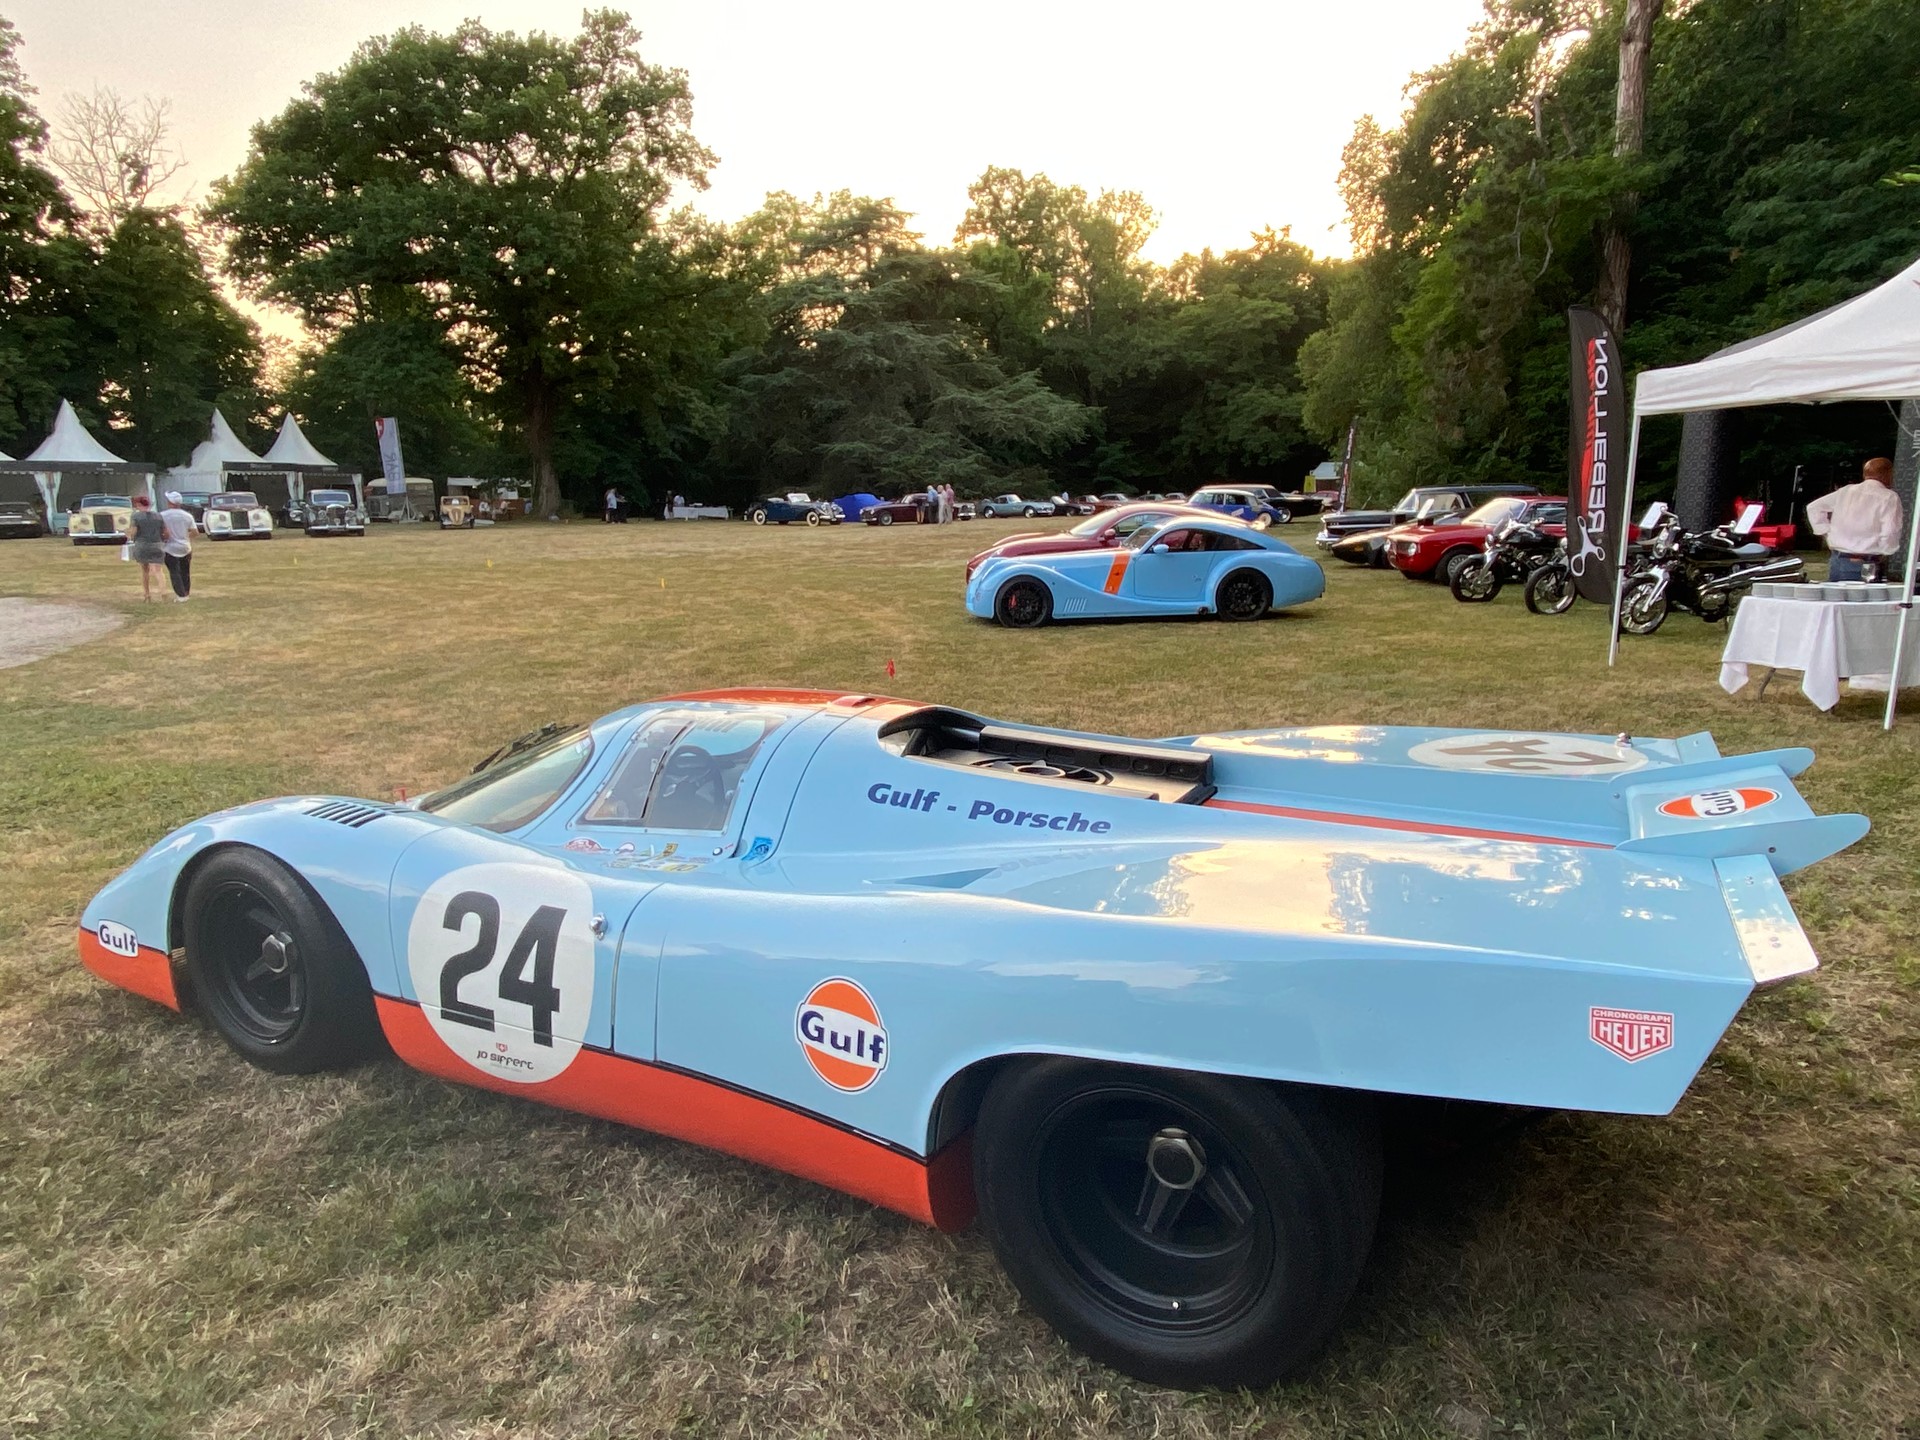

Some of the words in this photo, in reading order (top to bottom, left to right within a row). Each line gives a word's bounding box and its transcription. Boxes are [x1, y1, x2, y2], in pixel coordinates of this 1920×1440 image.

[1436, 739, 1628, 770] 24
[867, 783, 940, 812] Gulf
[968, 800, 1111, 834] Porsche
[1700, 790, 1738, 816] Gulf
[100, 924, 135, 953] Gulf
[440, 890, 567, 1048] 24
[1593, 1010, 1671, 1022] CHRONOGRAPH
[801, 1010, 884, 1063] Gulf
[1599, 1021, 1666, 1054] HEUER
